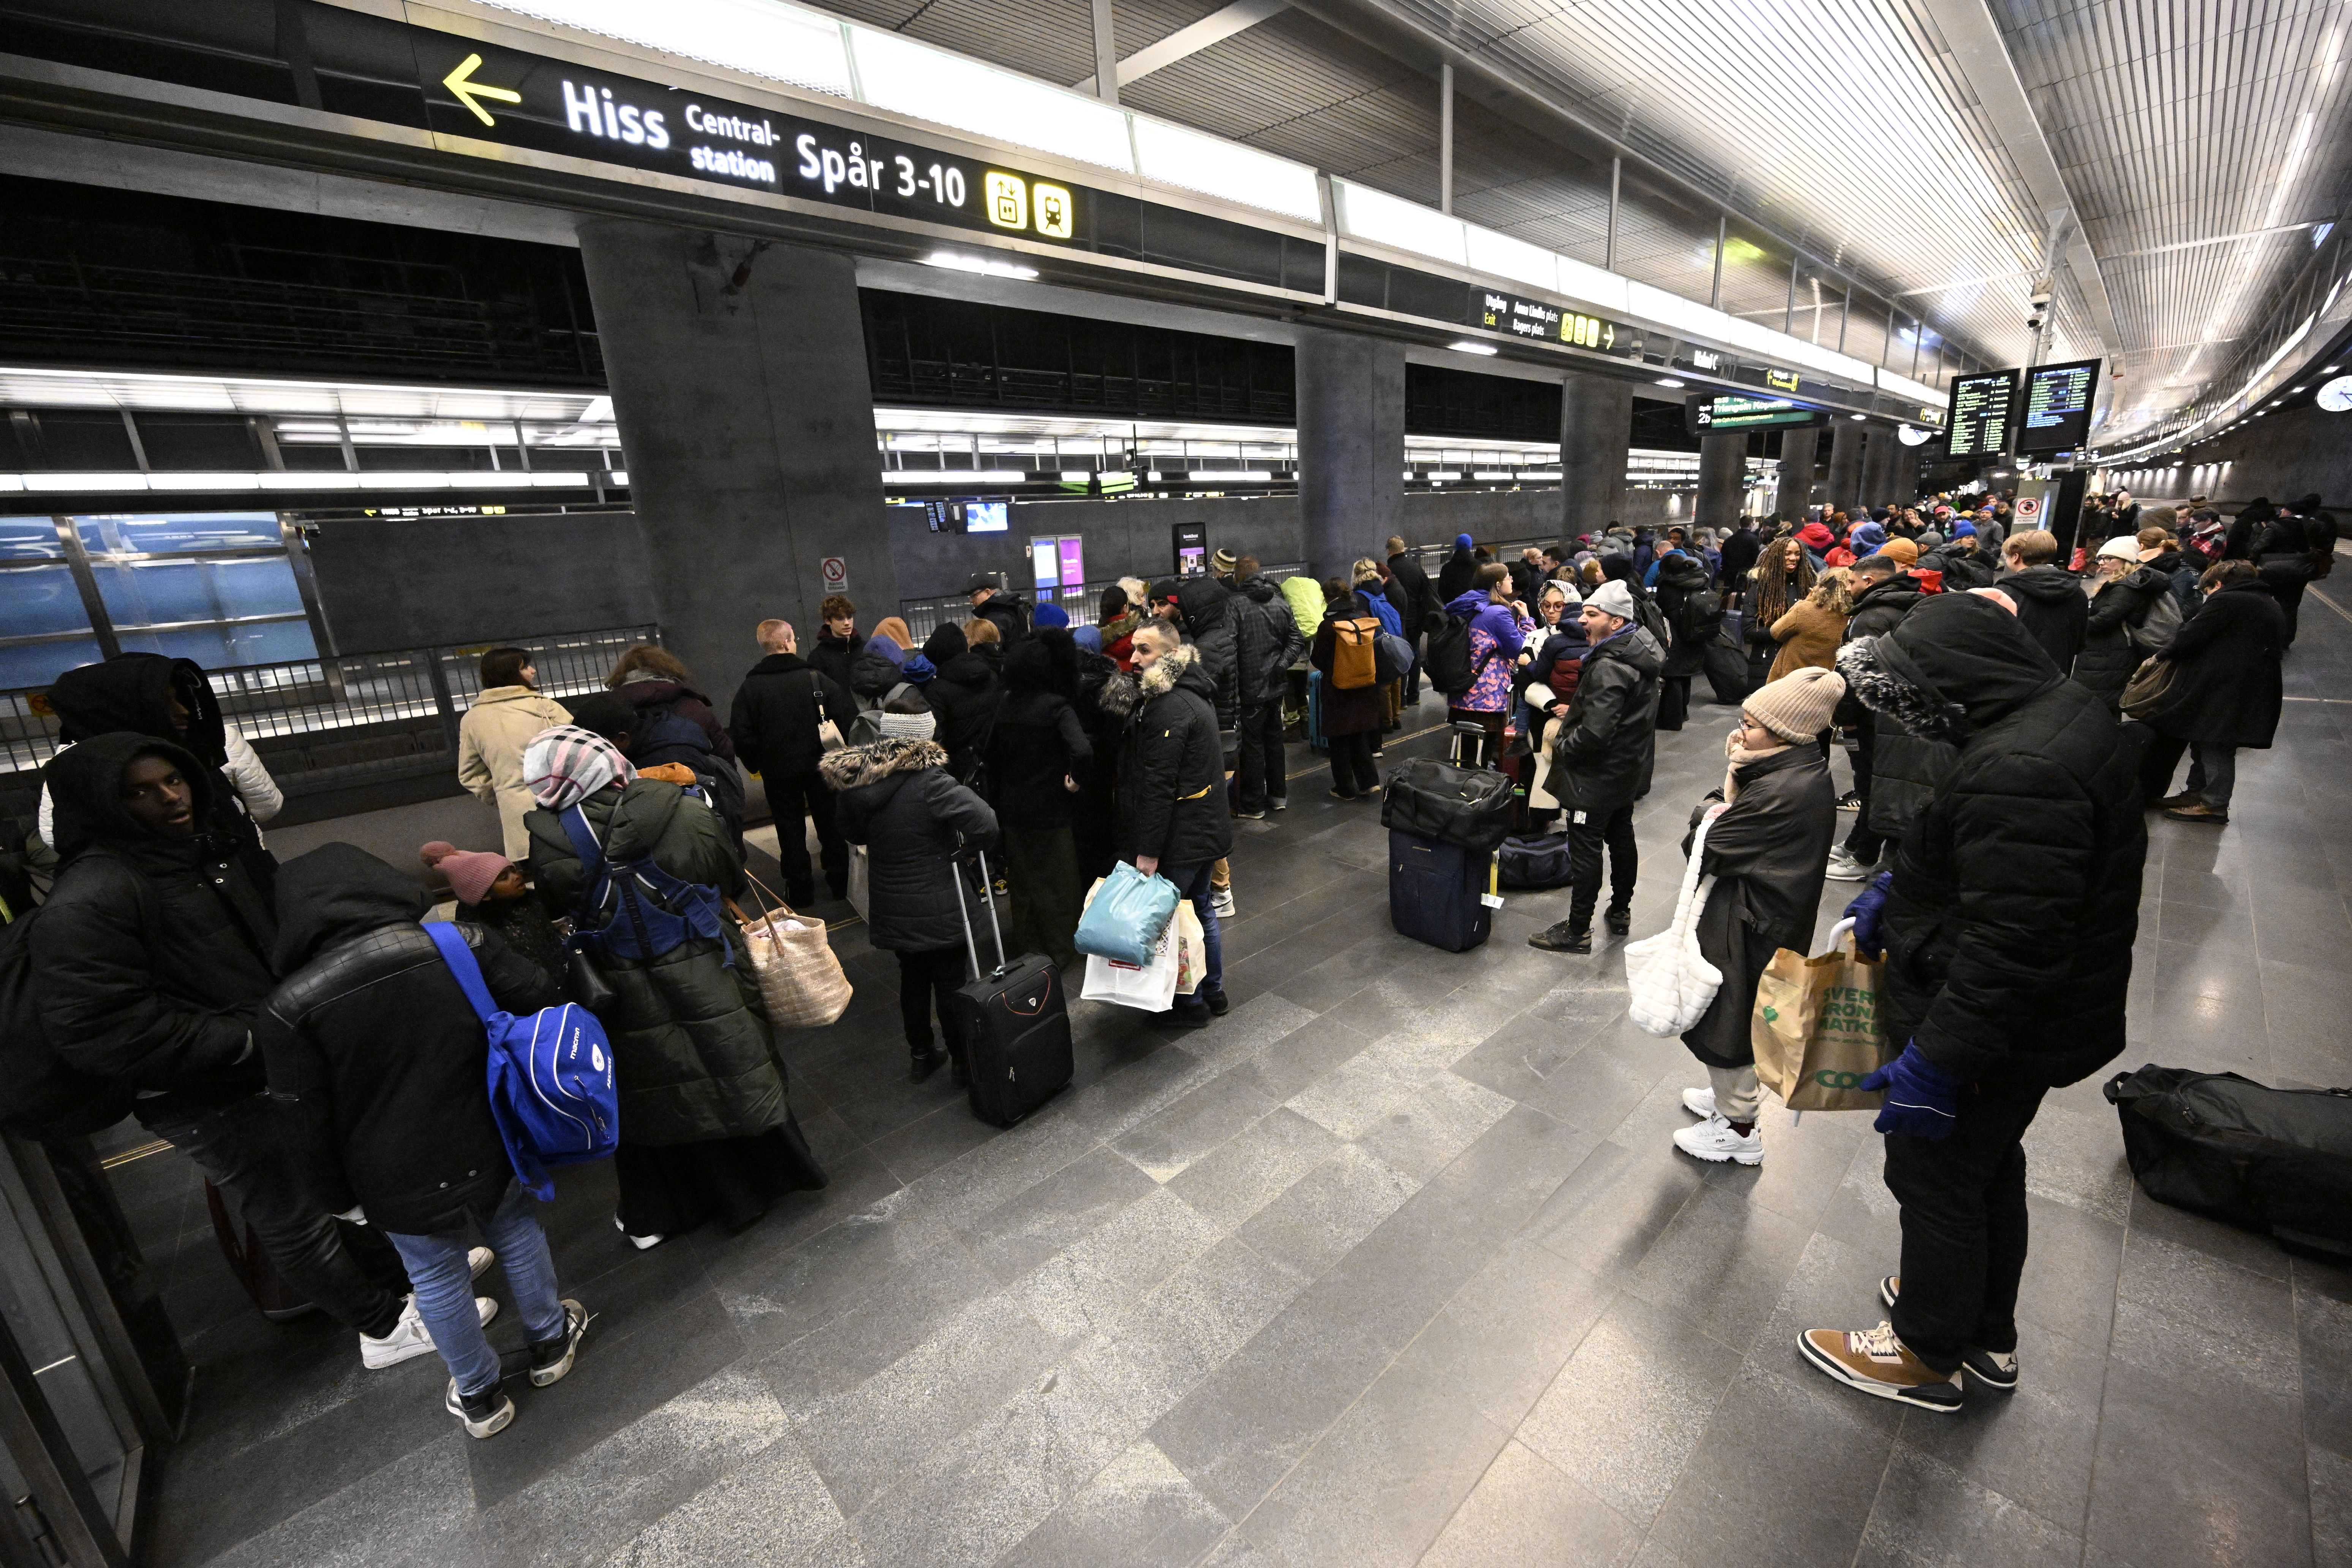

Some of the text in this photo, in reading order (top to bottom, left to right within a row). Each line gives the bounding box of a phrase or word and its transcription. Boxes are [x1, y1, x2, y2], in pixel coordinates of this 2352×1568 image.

[563, 79, 669, 150] Hiss
[685, 104, 781, 145] Central-
[691, 144, 776, 183] station
[796, 133, 967, 208] Spår 3-10
[1485, 294, 1507, 313] Utgång
[1514, 302, 1528, 315] Anna
[1546, 310, 1558, 323] plats
[1484, 312, 1496, 326] Exit
[1513, 318, 1544, 336] Bagers plats
[1698, 413, 1711, 424] 2b
[570, 1027, 580, 1060] macron
